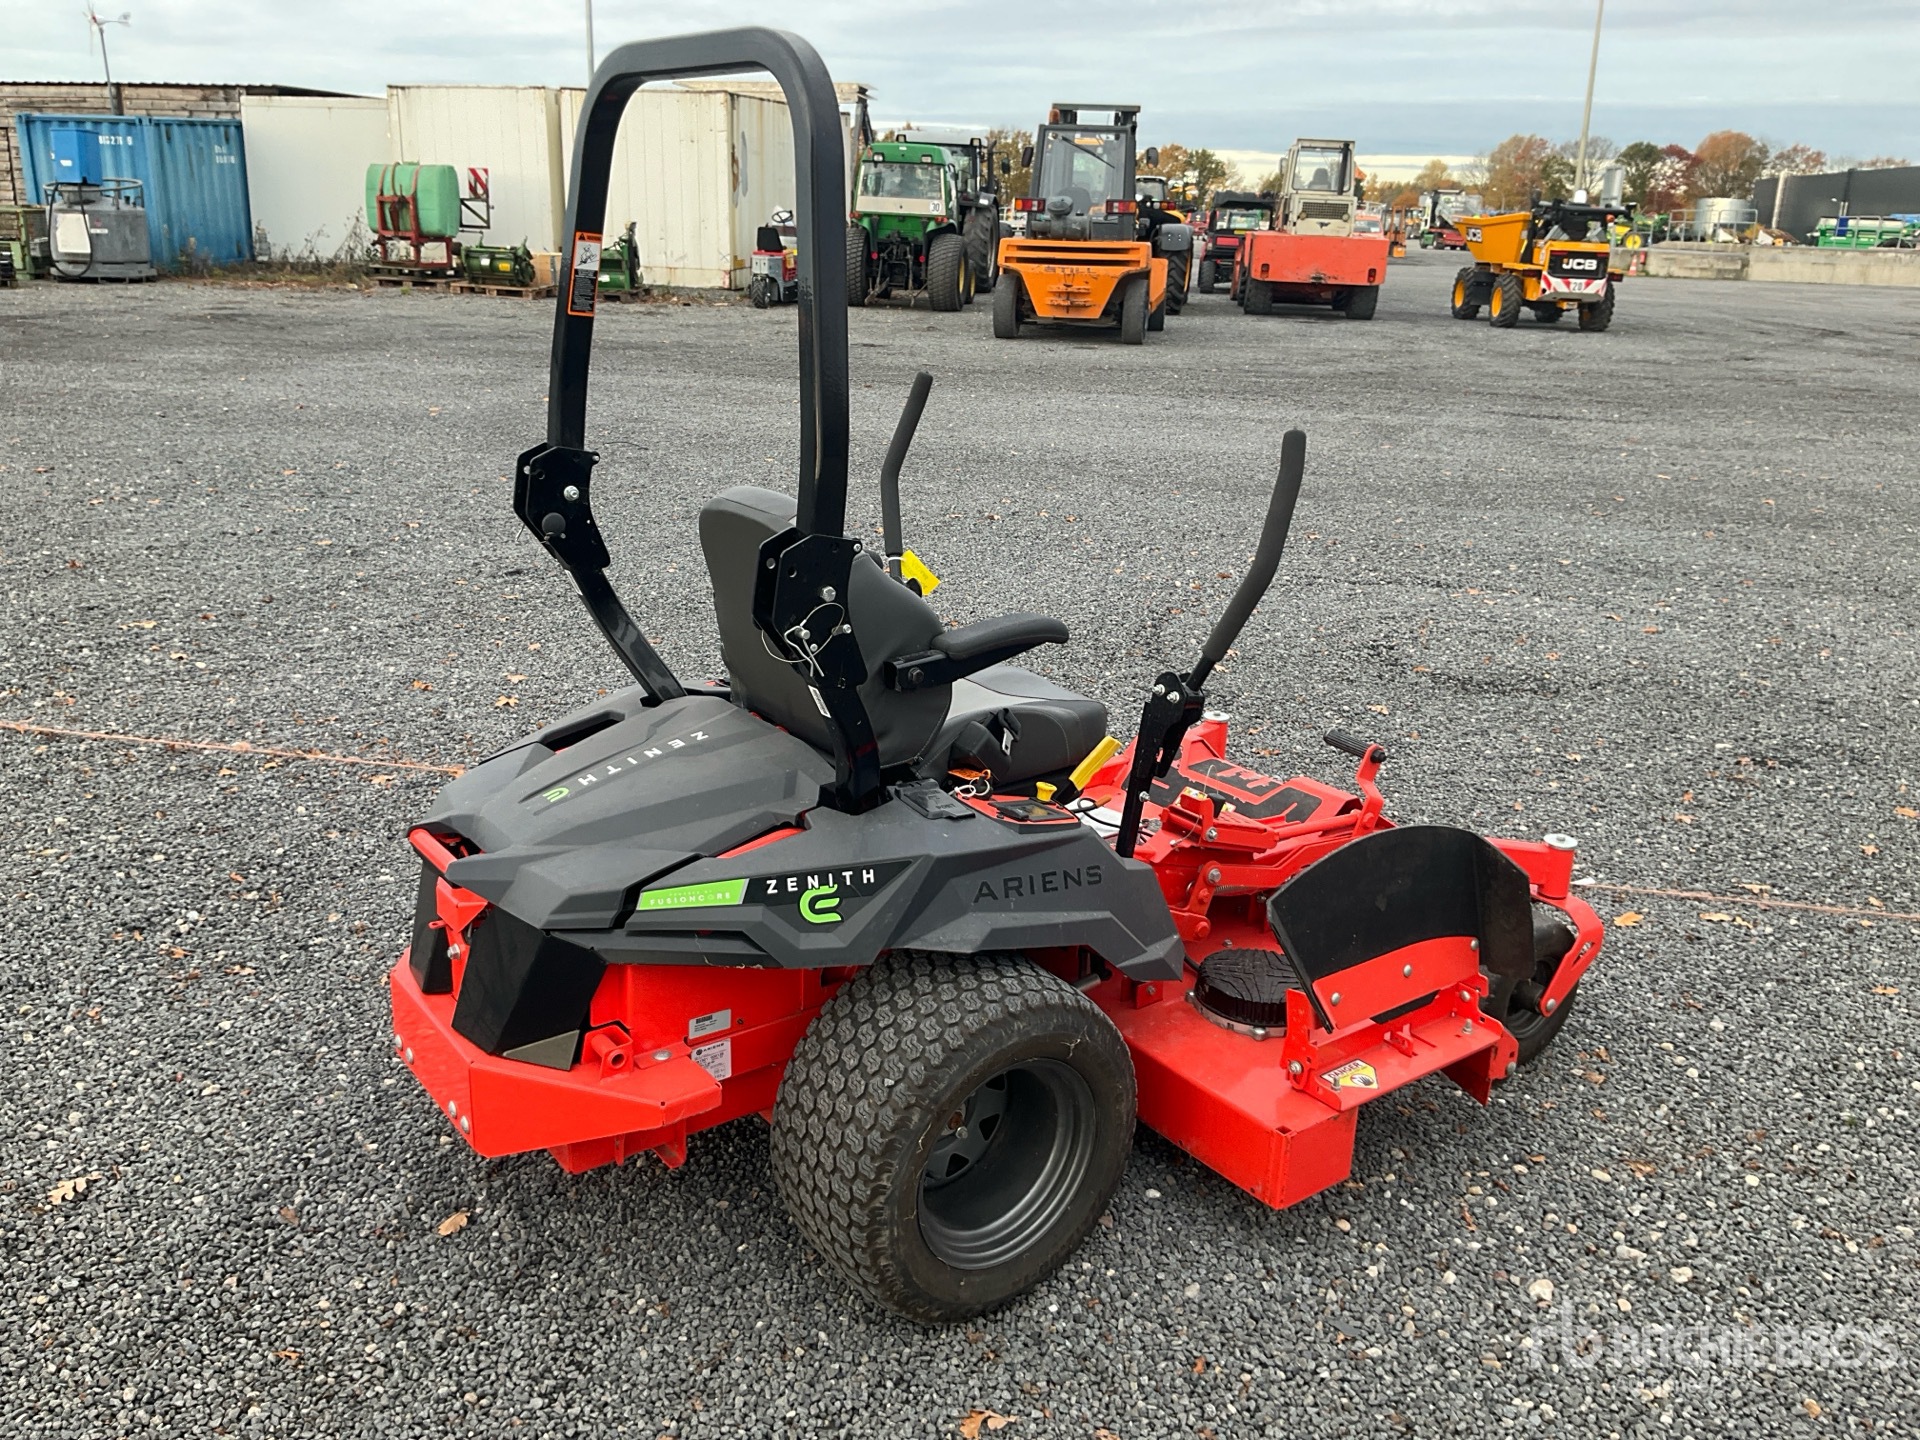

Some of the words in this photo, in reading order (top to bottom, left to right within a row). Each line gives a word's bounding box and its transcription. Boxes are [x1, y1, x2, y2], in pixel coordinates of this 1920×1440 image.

[931, 203, 940, 212] 30
[1466, 228, 1482, 242] JCB
[1562, 258, 1597, 270] JCB
[1572, 282, 1583, 291] 20
[578, 731, 709, 786] ZENITH
[766, 868, 875, 895] ZENITH
[973, 865, 1103, 903] ARIENS
